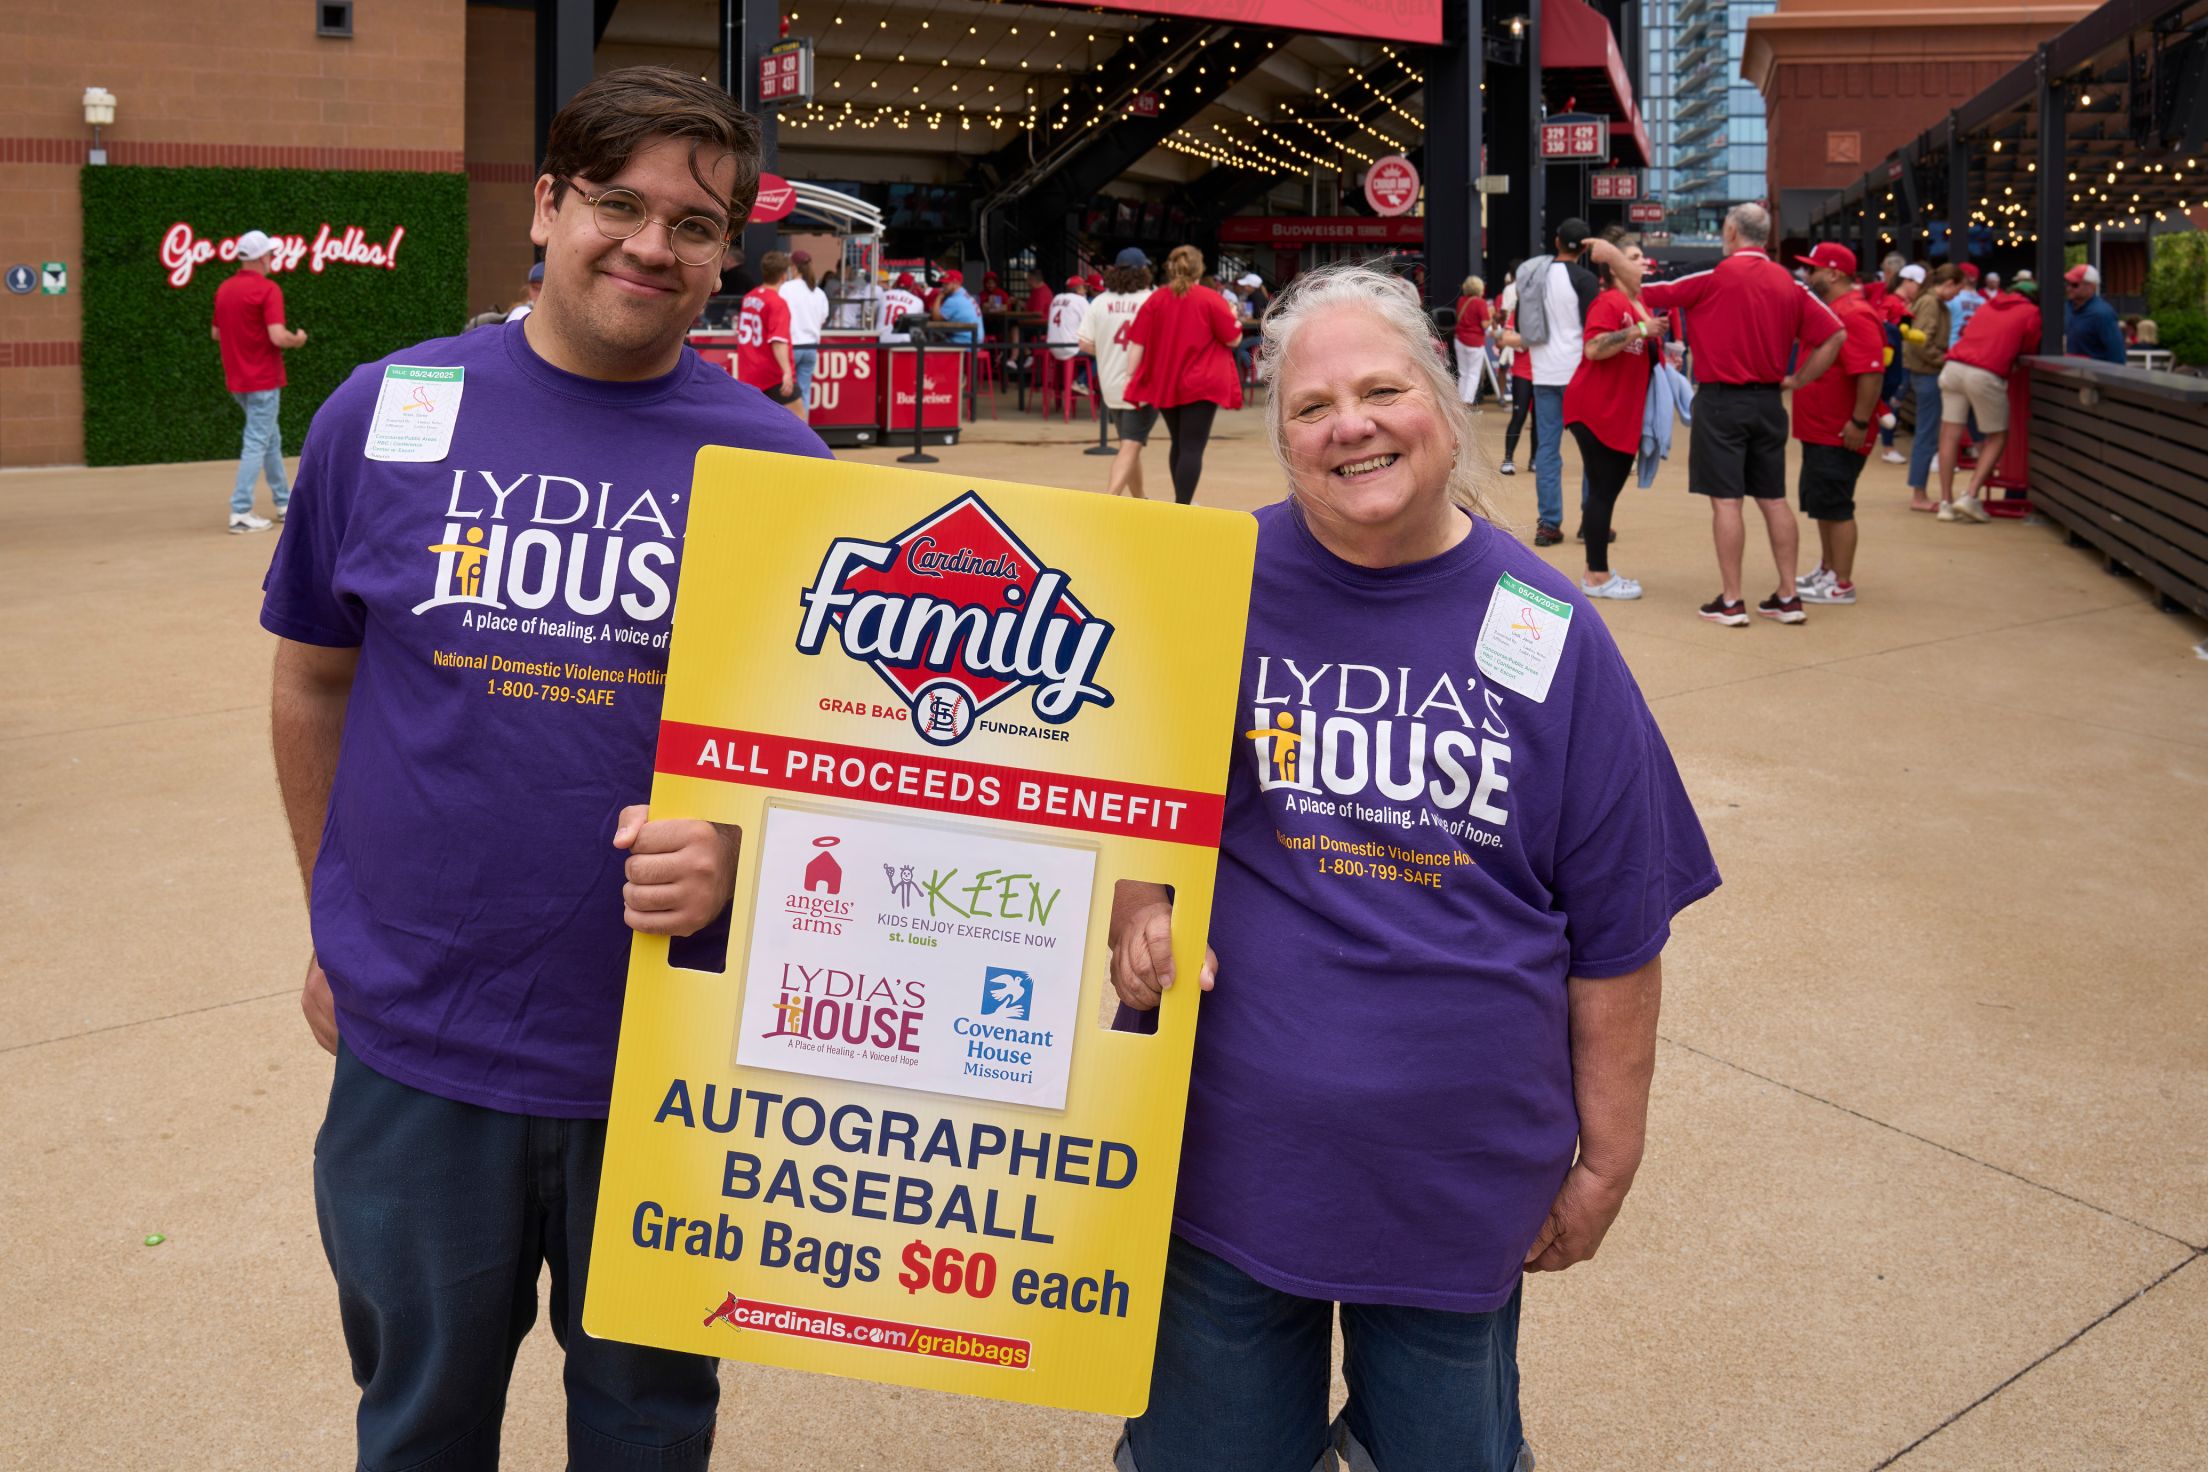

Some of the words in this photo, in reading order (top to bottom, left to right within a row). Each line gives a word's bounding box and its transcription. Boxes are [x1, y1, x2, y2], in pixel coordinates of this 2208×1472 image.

[1272, 223, 1354, 237] BUDWEISER
[161, 222, 215, 287] Go
[219, 236, 306, 272] czy
[311, 223, 404, 271] folks!
[1107, 301, 1138, 314] MOLIN
[738, 311, 763, 348] 59
[409, 370, 454, 379] 05/24/2025
[814, 350, 871, 380] UD'S
[445, 469, 687, 539] LYDIA'
[428, 522, 677, 624] HOUS
[906, 536, 1019, 581] Cardinals
[1518, 585, 1561, 613] 05/24/2025
[462, 610, 473, 628] A
[477, 613, 518, 632] place
[521, 616, 537, 634] of
[539, 619, 597, 643] healing.
[600, 624, 611, 641] A
[614, 627, 650, 646] voice
[652, 631, 669, 650] of
[795, 537, 1116, 725] Family
[433, 650, 488, 669] National
[491, 655, 562, 679] Domestic
[565, 663, 625, 684] Violence
[487, 678, 616, 707] 1-800-799-SAFE
[818, 697, 867, 717] GRAB
[871, 704, 908, 722] BAG
[1254, 656, 1509, 739] LYDIA'S
[979, 720, 1071, 743] FUNDRAISER
[697, 737, 769, 775] ALL
[785, 750, 1002, 807] PROCEEDS
[1017, 783, 1188, 831] BENEFIT
[1250, 707, 1512, 826] HOUSE
[1285, 793, 1297, 811] A
[1299, 796, 1336, 815] place
[1339, 801, 1353, 818] of
[1356, 803, 1416, 829] healing.
[1419, 807, 1431, 826] A
[1450, 819, 1466, 836] of
[1465, 822, 1504, 848] hope.
[1320, 834, 1385, 857] Domestic
[1388, 844, 1451, 866] Violence
[1319, 857, 1442, 888] 1-800-799-SAFE
[785, 892, 855, 919] angels'
[921, 867, 1061, 926] KEEN
[791, 917, 843, 936] arms
[877, 913, 909, 929] KIDS
[911, 918, 955, 935] ENJOY
[957, 923, 1022, 945] EXERCISE
[1024, 933, 1057, 949] NOW
[888, 932, 905, 945] st.
[907, 933, 939, 948] louis
[780, 962, 927, 1009] LYDIA'S
[772, 992, 924, 1053] HOUSE
[953, 1016, 1054, 1048] Covenant
[787, 1039, 794, 1049] A
[795, 1040, 817, 1052] Place
[817, 1042, 826, 1053] of
[826, 1044, 855, 1060] Healing
[862, 1050, 869, 1060] A
[870, 1050, 890, 1063] Voice
[890, 1053, 899, 1064] of
[900, 1054, 919, 1067] Hope
[967, 1039, 1033, 1066] House
[963, 1062, 1034, 1085] Missouri
[653, 1077, 1139, 1191] AUTOGRAPHED
[721, 1150, 1056, 1245] BASEBALL
[631, 1200, 744, 1263] Grab
[759, 1219, 882, 1289] Bags
[898, 1238, 998, 1299] $60
[1010, 1266, 1131, 1319] each
